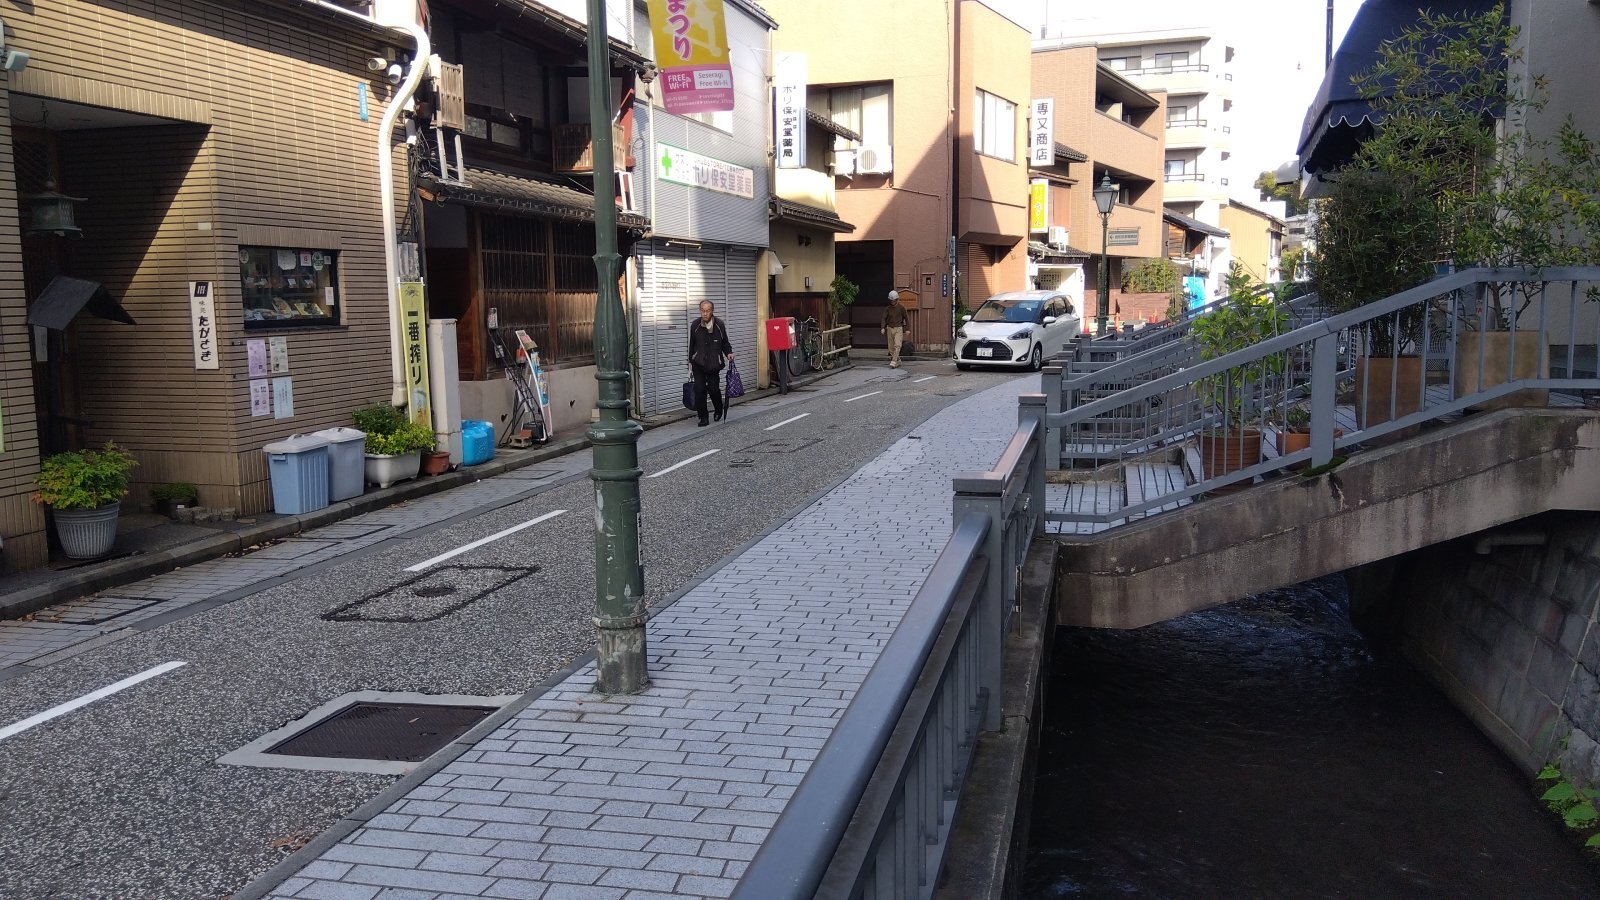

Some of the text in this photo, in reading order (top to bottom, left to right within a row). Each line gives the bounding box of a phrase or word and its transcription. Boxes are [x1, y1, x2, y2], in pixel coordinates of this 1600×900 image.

[666, 0, 691, 59] まつり
[668, 73, 686, 82] FREE
[669, 81, 689, 90] Wi-Fi
[698, 71, 724, 79] Seseragi
[782, 85, 793, 158] ホリ保安堂薬局
[1035, 102, 1048, 161] 専又商店
[692, 164, 752, 195] ホリ保安堂薬局
[407, 310, 422, 385] 一番搾り
